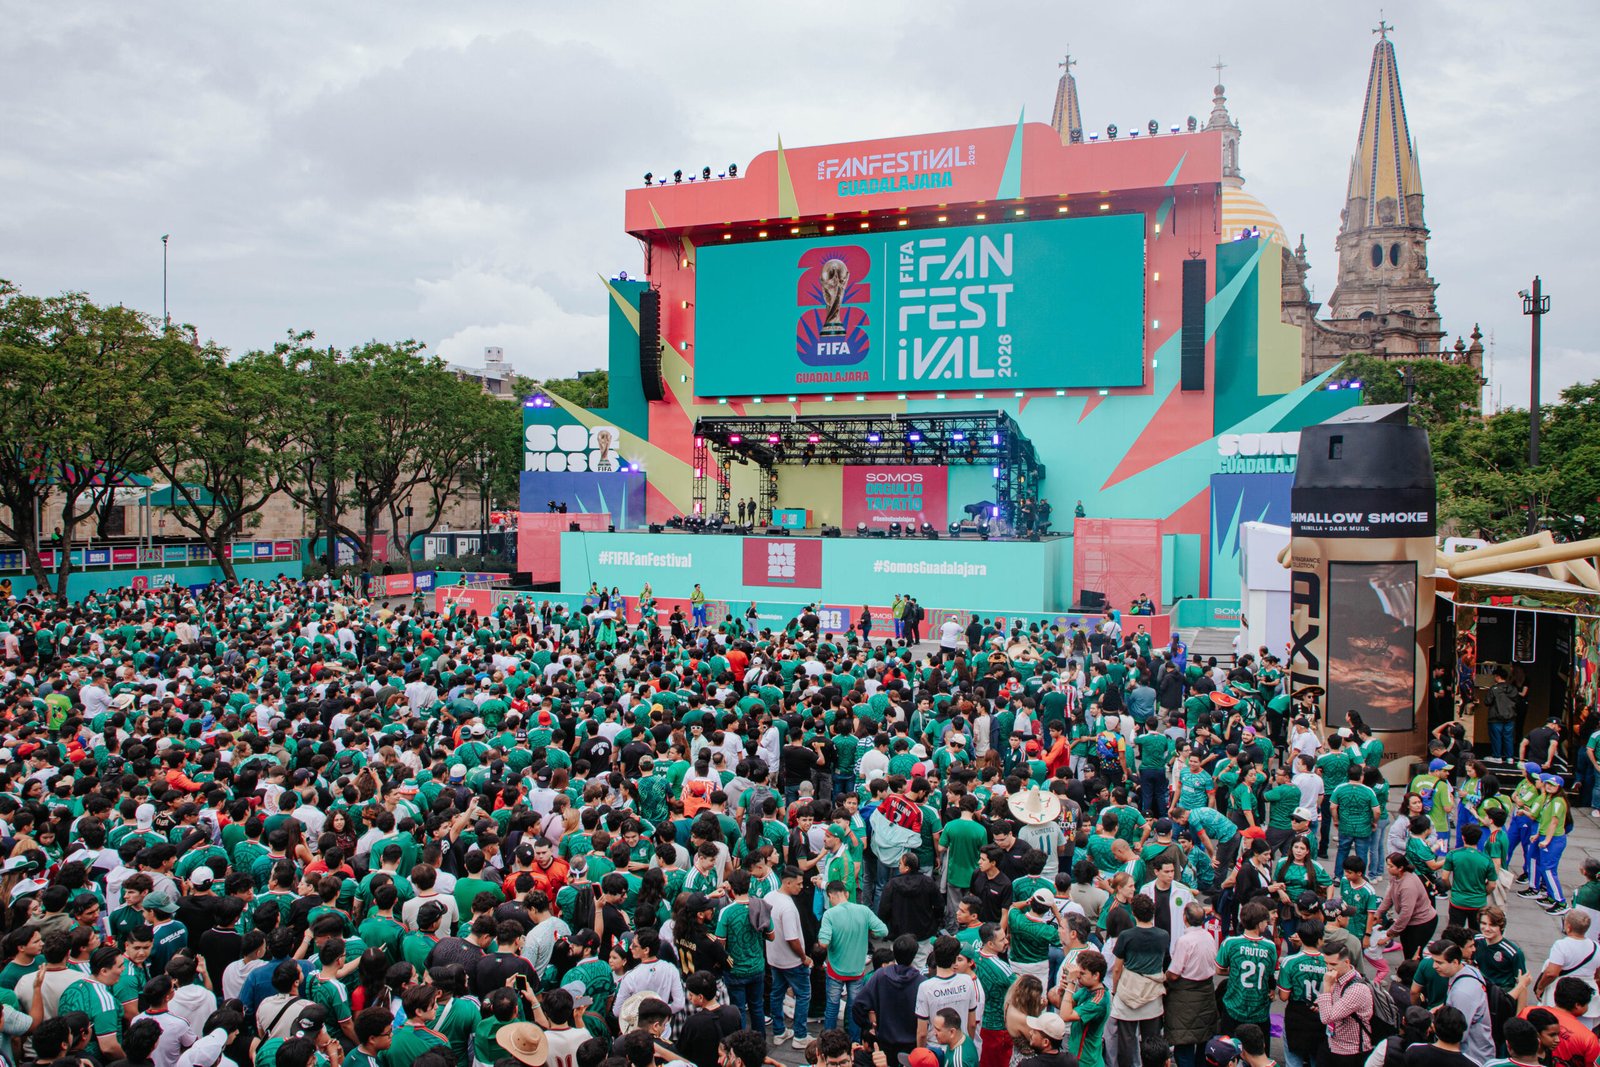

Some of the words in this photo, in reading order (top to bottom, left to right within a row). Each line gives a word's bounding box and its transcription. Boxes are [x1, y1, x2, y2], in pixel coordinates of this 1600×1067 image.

[817, 160, 825, 180] FIFA
[968, 144, 976, 166] 2026
[837, 171, 953, 197] GUADALAJARA
[900, 240, 914, 283] FIFA
[919, 233, 1013, 281] FAN
[899, 283, 1014, 331] FEST
[817, 341, 851, 356] FIFA
[997, 333, 1012, 378] 2026
[796, 370, 869, 383] GUADALAJARA
[866, 473, 923, 482] SOMOS
[866, 483, 923, 495] ORGULLO
[866, 494, 923, 511] TAPATÍO
[1368, 511, 1428, 523] SMOKE
[768, 542, 796, 556] WE
[598, 551, 692, 568] #FIFAFanFestival
[873, 559, 987, 577] #SomosGuadalajara
[1240, 945, 1269, 958] FRUTOS
[1240, 960, 1266, 990] 21
[933, 984, 967, 999] OMNILIFE
